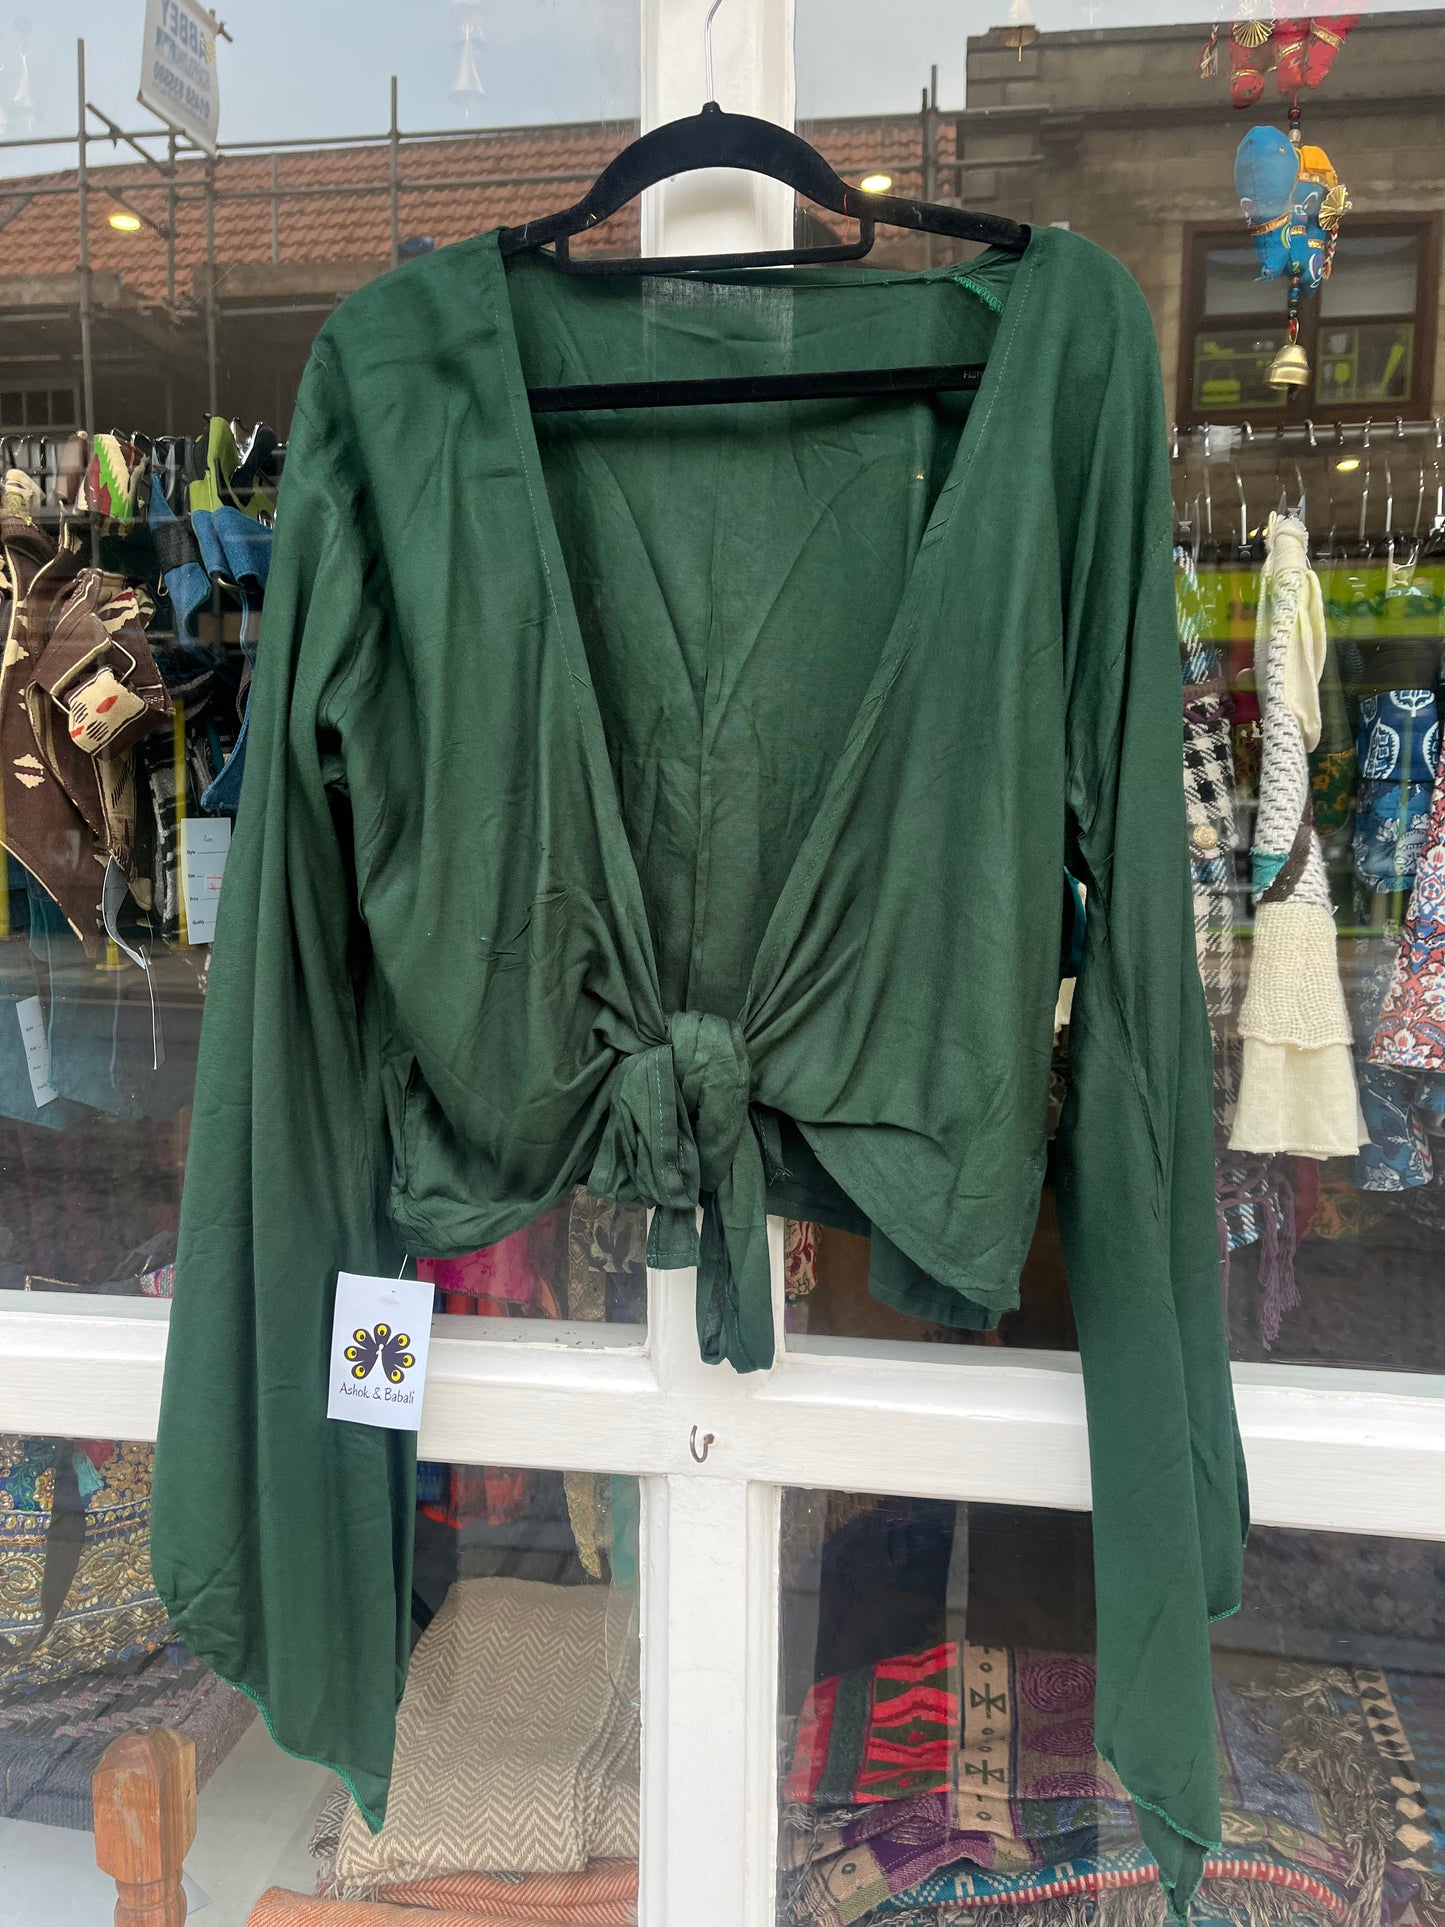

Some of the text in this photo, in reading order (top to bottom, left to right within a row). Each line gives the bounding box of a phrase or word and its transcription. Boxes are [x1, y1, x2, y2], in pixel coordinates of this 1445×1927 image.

[339, 1381, 415, 1404] Ashok & Babali
